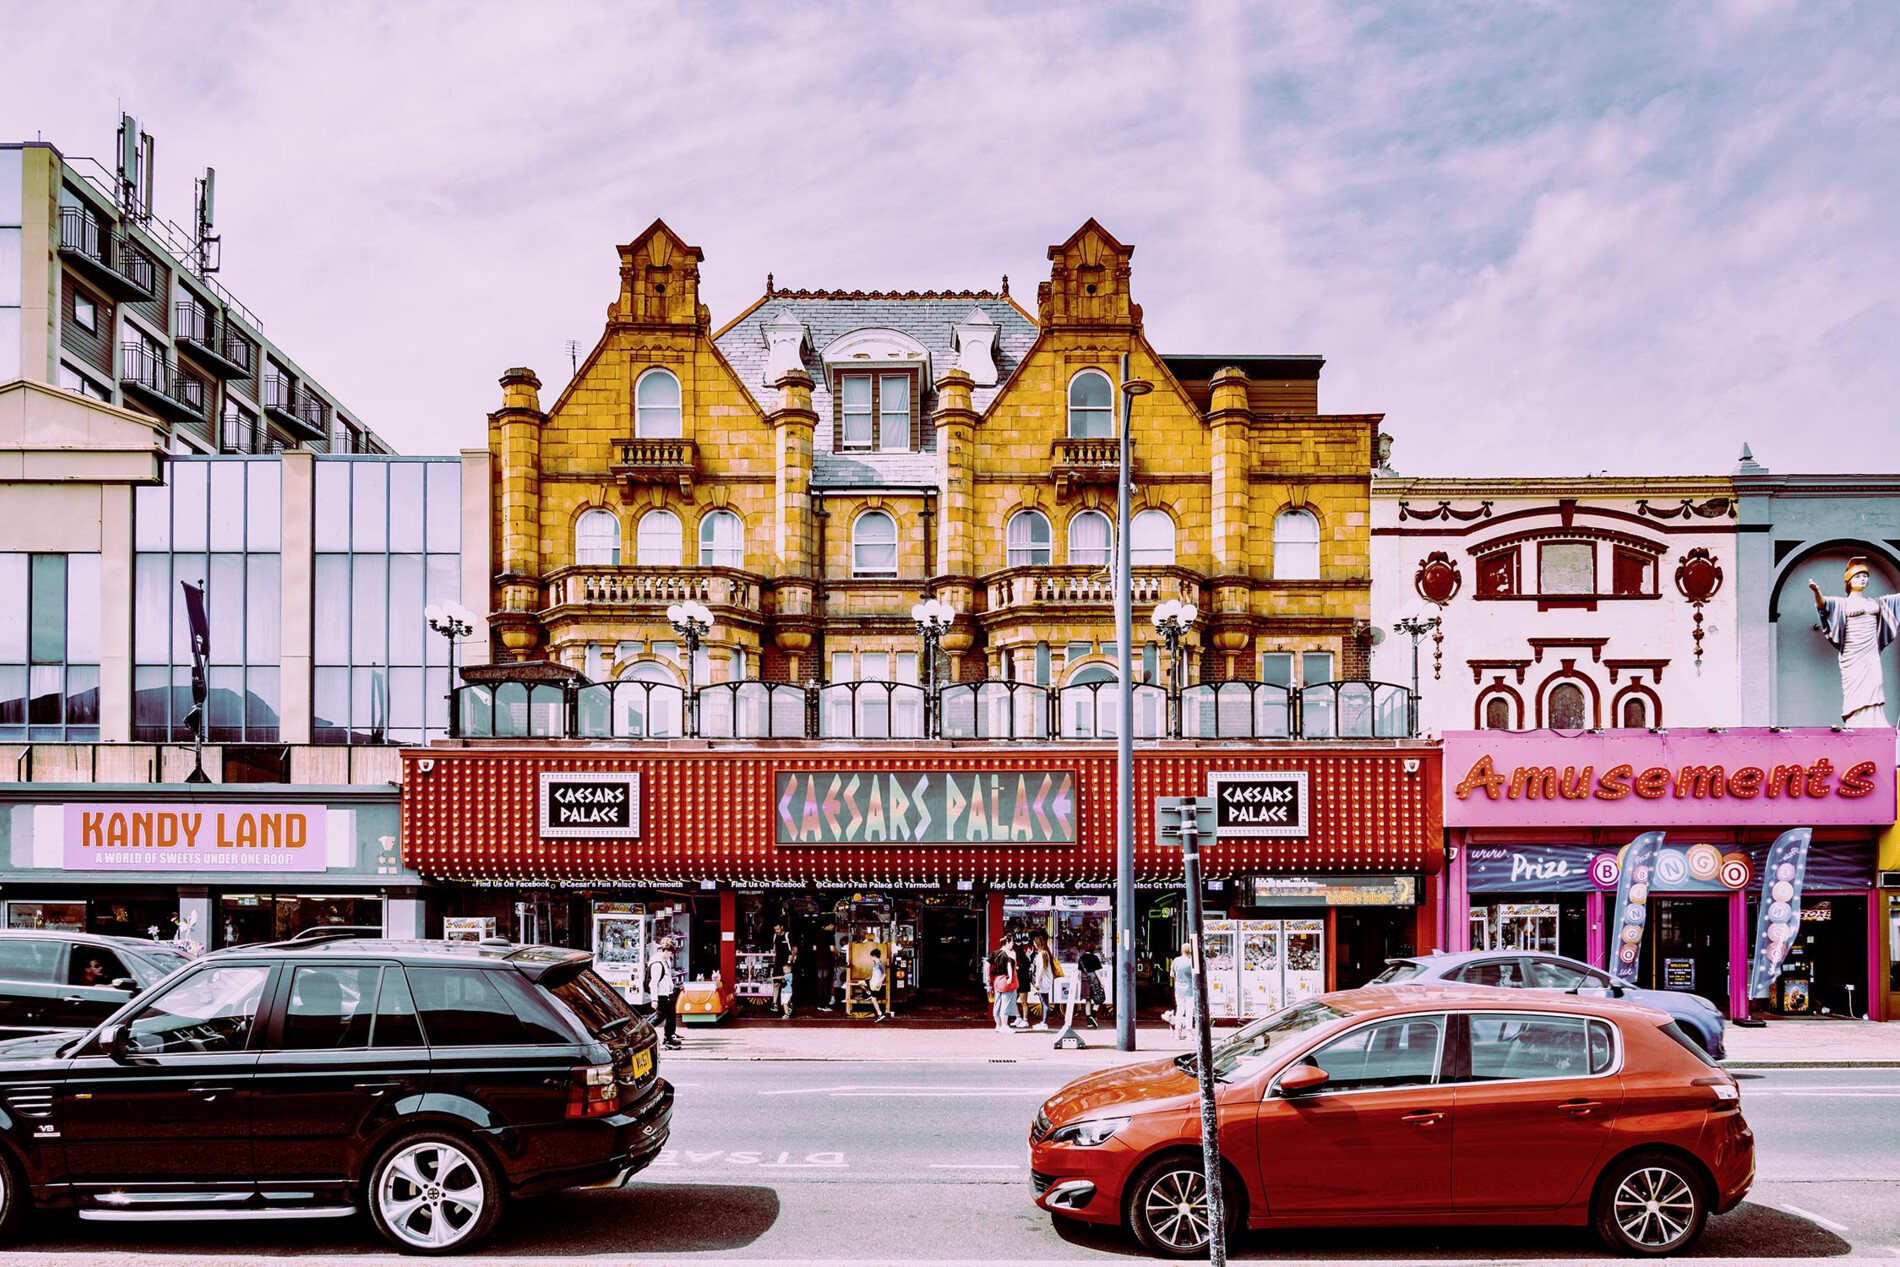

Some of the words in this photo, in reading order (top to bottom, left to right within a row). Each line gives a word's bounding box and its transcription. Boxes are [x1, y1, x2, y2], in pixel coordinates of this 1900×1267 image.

[1454, 754, 1877, 800] Amusements
[554, 787, 625, 804] CAESARS
[1222, 786, 1294, 802] CAESARS
[560, 806, 619, 823] PALACE
[778, 773, 932, 842] CAESARS
[946, 773, 1073, 842] PALACE
[1228, 806, 1288, 822] PALACE
[82, 811, 201, 848] KANDY
[216, 812, 307, 849] LAND
[95, 852, 103, 864] A
[104, 852, 142, 865] WORLD
[144, 852, 157, 865] OF
[159, 853, 201, 865] SWEETS
[203, 853, 239, 865] UNDER
[241, 853, 262, 865] ONE
[263, 853, 294, 865] ROOF!
[475, 880, 492, 889] Find
[493, 880, 502, 889] Us
[504, 880, 514, 889] On
[516, 880, 550, 889] Facebook
[559, 880, 596, 889] @Caesar's
[598, 880, 611, 889] Fun
[613, 880, 636, 889] Palace
[638, 880, 647, 889] Gt
[648, 880, 684, 889] Yarmouth
[731, 880, 747, 889] Find
[748, 880, 758, 889] Us
[759, 880, 770, 889] On
[771, 880, 806, 889] Facebook
[815, 880, 853, 889] @Caesar's
[854, 880, 868, 889] Fun
[869, 880, 892, 889] Palace
[894, 880, 903, 889] Gt
[904, 880, 940, 889] Yarmouth
[990, 881, 1005, 889] Find
[1007, 881, 1017, 889] Us
[1018, 881, 1028, 889] On
[1030, 881, 1065, 889] Facebook
[1074, 881, 1112, 889] @Caesar's
[1133, 881, 1152, 889] alace
[1153, 881, 1163, 889] Gt
[1164, 881, 1187, 889] Yarmo
